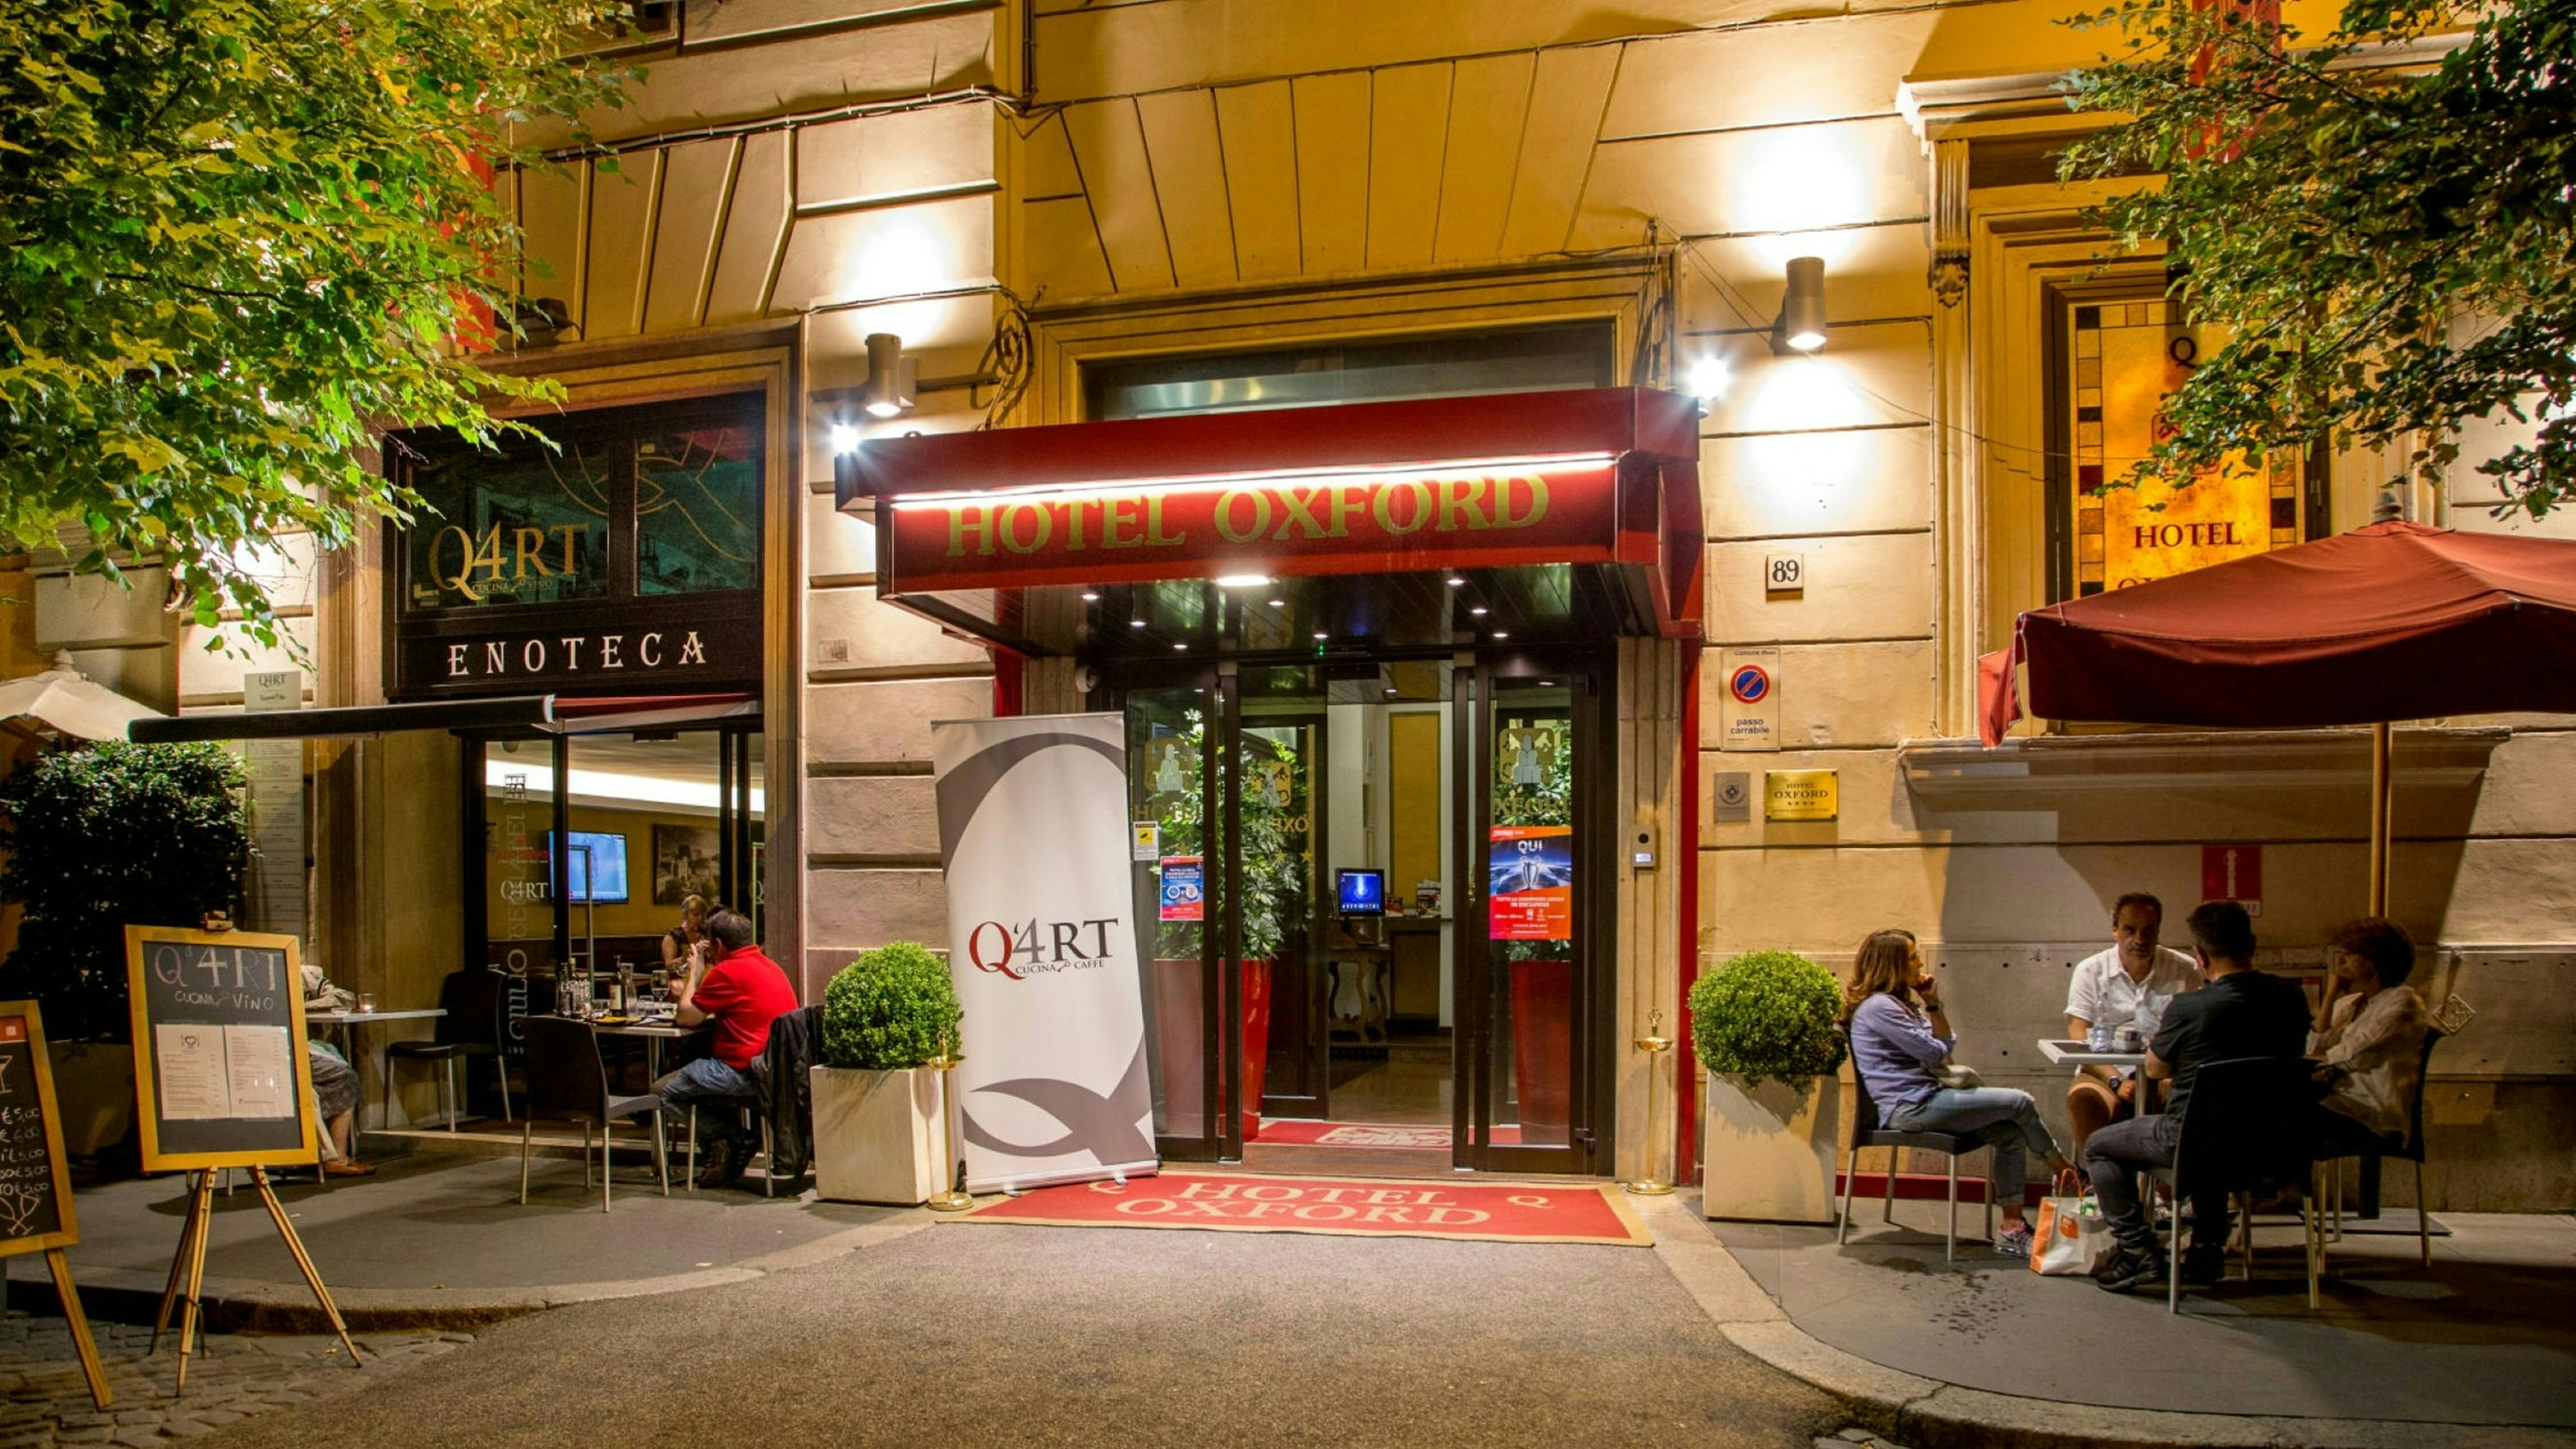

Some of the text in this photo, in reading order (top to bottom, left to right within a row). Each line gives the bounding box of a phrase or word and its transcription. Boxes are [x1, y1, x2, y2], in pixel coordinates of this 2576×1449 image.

[2168, 336, 2196, 369] Q
[945, 472, 1551, 558] HOTEL OXFORD
[2135, 521, 2243, 549] HOTEL
[1771, 559, 1800, 583] 89
[447, 630, 708, 677] ENOTECA
[1729, 726, 1770, 735] carrabile
[1736, 718, 1764, 727] passo
[1774, 790, 1828, 798] OXFORD
[1517, 840, 1543, 853] QUI
[1015, 964, 1057, 975] CUCINA
[1170, 1182, 1458, 1205] HOTEL
[1506, 1194, 1556, 1210] Q
[1116, 1198, 1492, 1226] OXFORD
